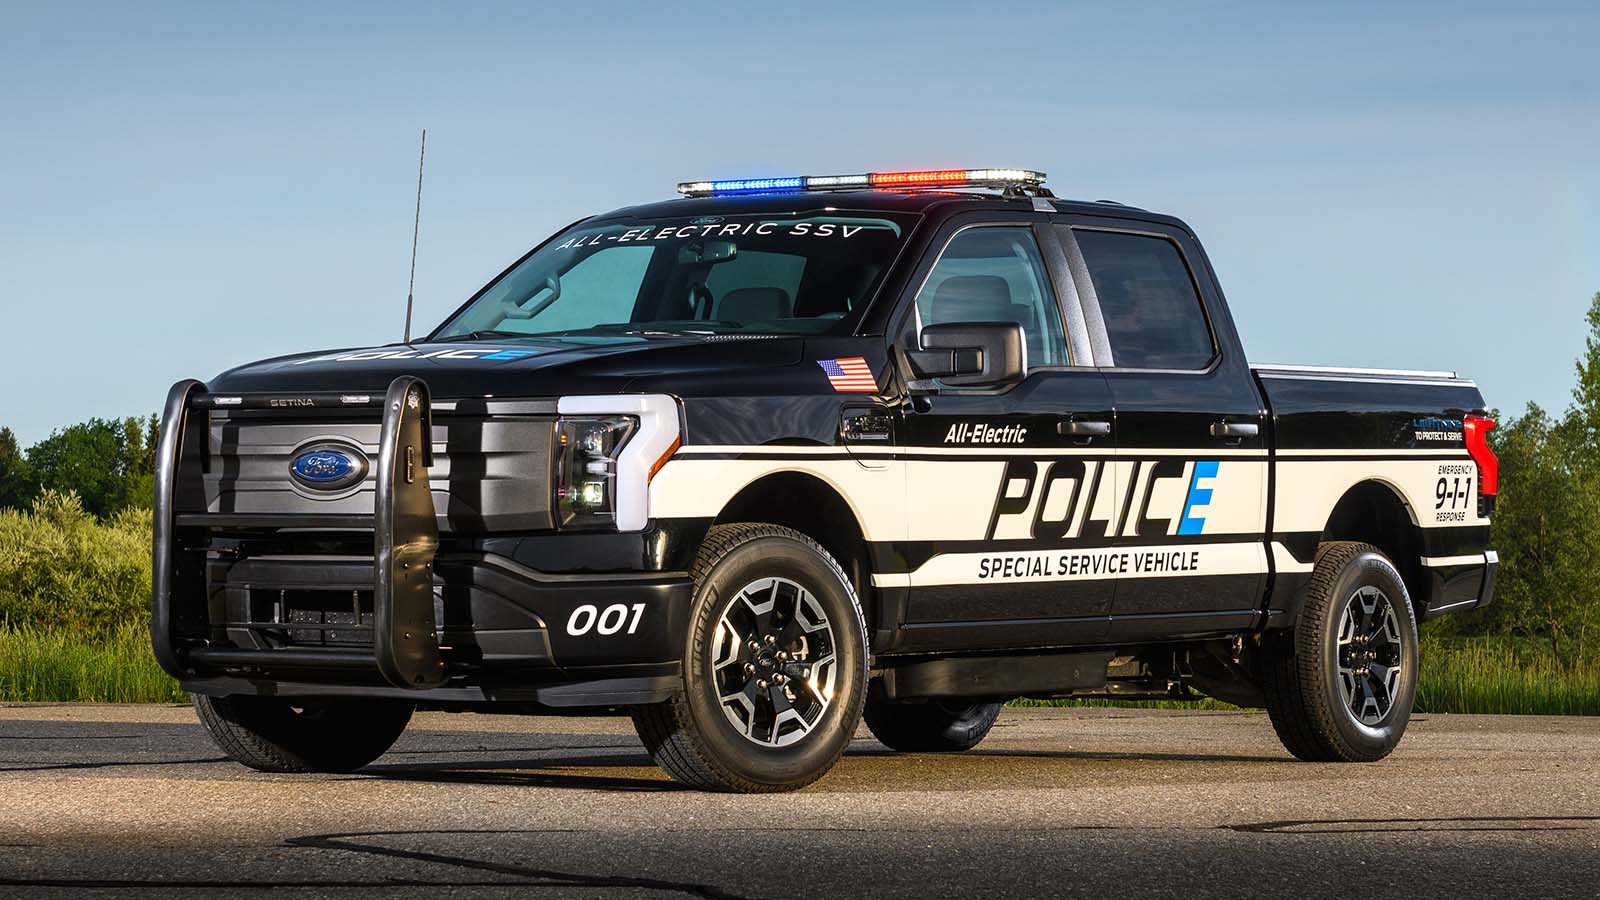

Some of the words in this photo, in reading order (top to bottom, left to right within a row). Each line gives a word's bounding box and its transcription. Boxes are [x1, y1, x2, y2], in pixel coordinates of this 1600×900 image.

[555, 223, 778, 251] ALL-ELECTRIC
[789, 223, 863, 238] SSV
[270, 398, 315, 407] SETINA
[943, 423, 1027, 443] All-Electric
[1414, 431, 1422, 440] TO
[1423, 431, 1443, 440] PROTECT
[1447, 432, 1462, 441] SERVE
[304, 456, 340, 475] Ford
[1438, 465, 1473, 475] EMERGENCY
[984, 461, 1220, 541] POLICE
[1435, 477, 1471, 509] 9-1-1
[1436, 511, 1465, 522] RESPONSE
[978, 556, 1052, 578] SPECIAL
[1058, 553, 1129, 576] SERVICE
[1134, 551, 1199, 572] VEHICLE
[566, 603, 646, 636] 001
[693, 589, 718, 675] MICHELIN
